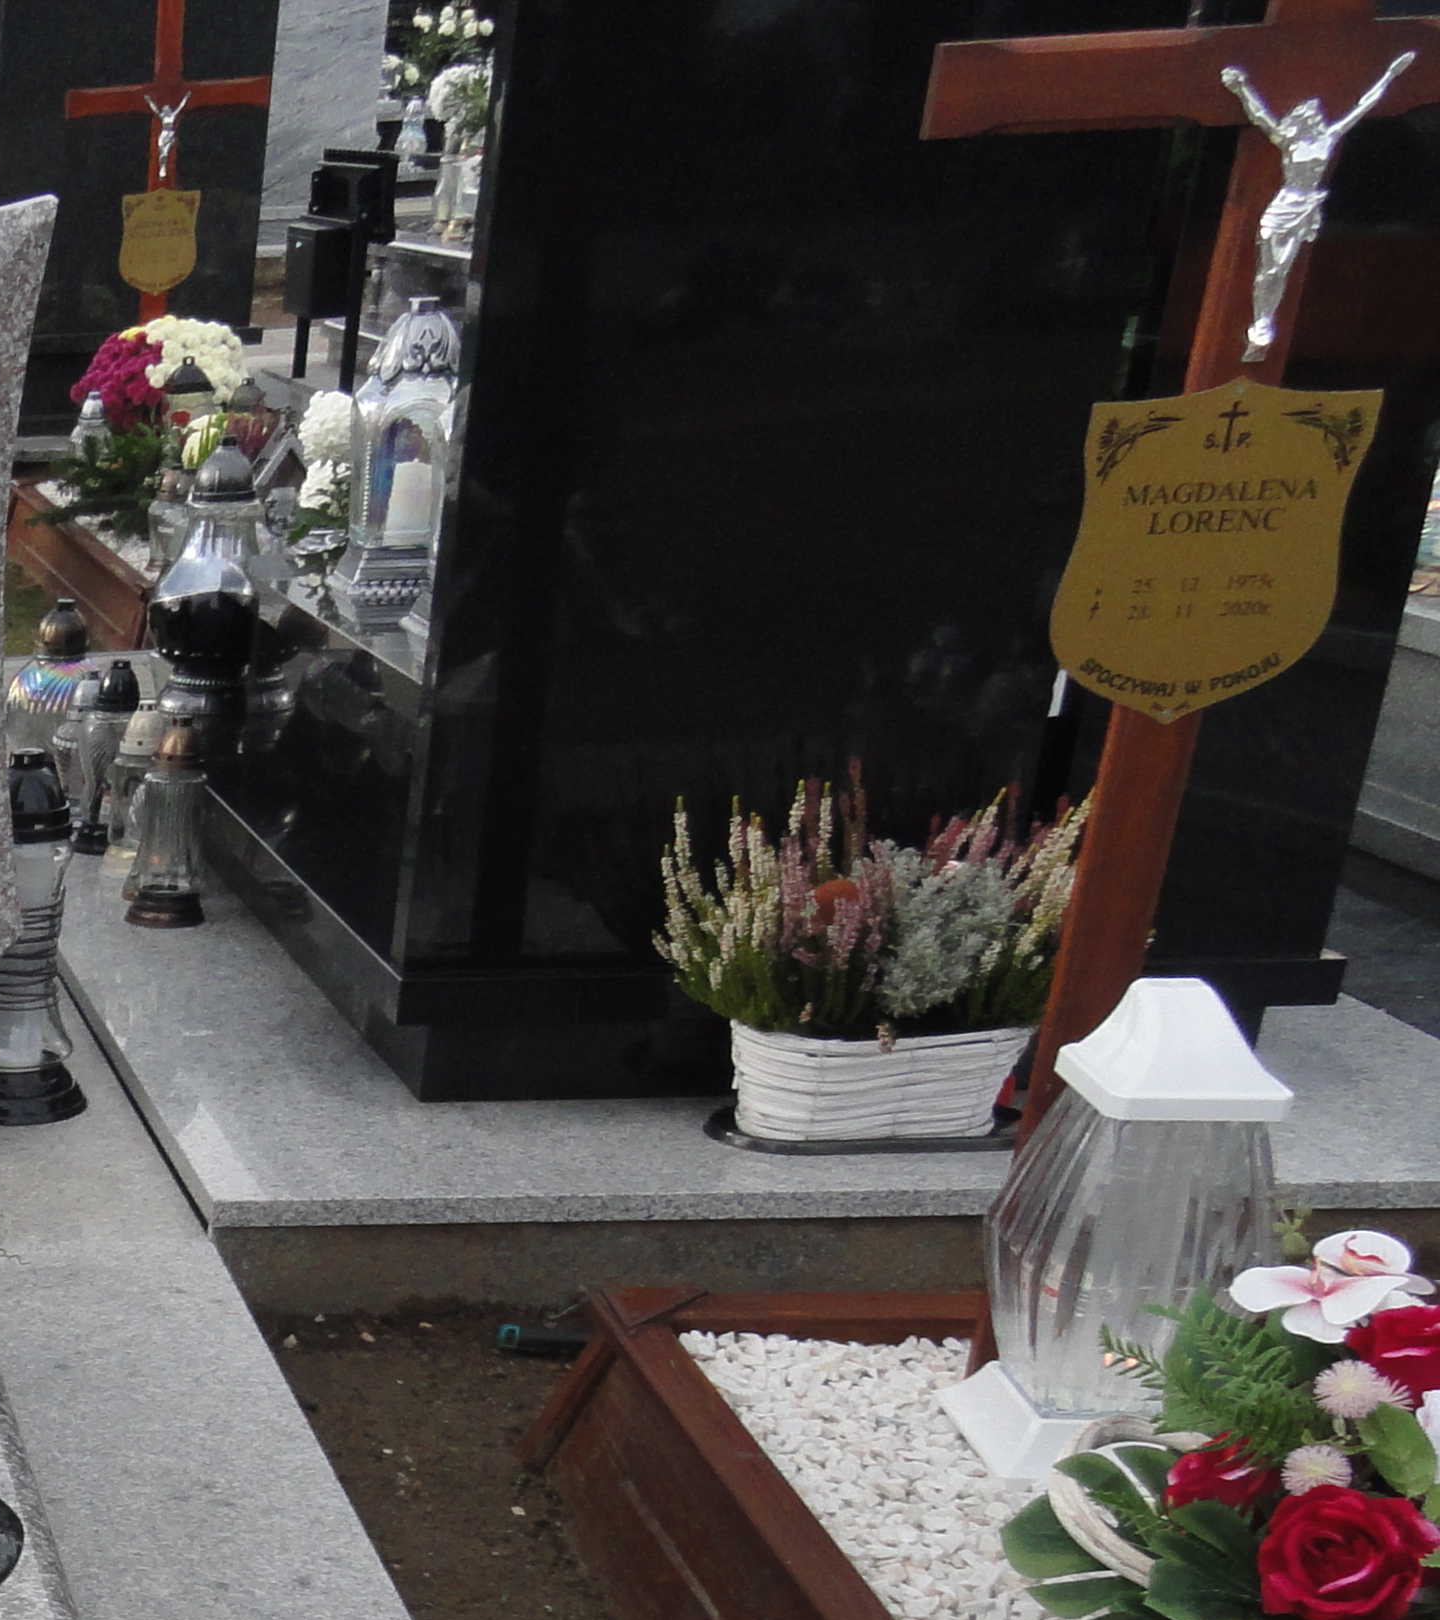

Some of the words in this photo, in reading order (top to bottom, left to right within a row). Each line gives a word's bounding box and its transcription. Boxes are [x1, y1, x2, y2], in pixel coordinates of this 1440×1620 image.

[1121, 478, 1318, 507] MAGDALENA
[1145, 506, 1287, 537] LORENC
[1079, 657, 1176, 698] SPOCZYWAJ
[1184, 680, 1203, 696] W
[1209, 651, 1281, 692] POKOJU
